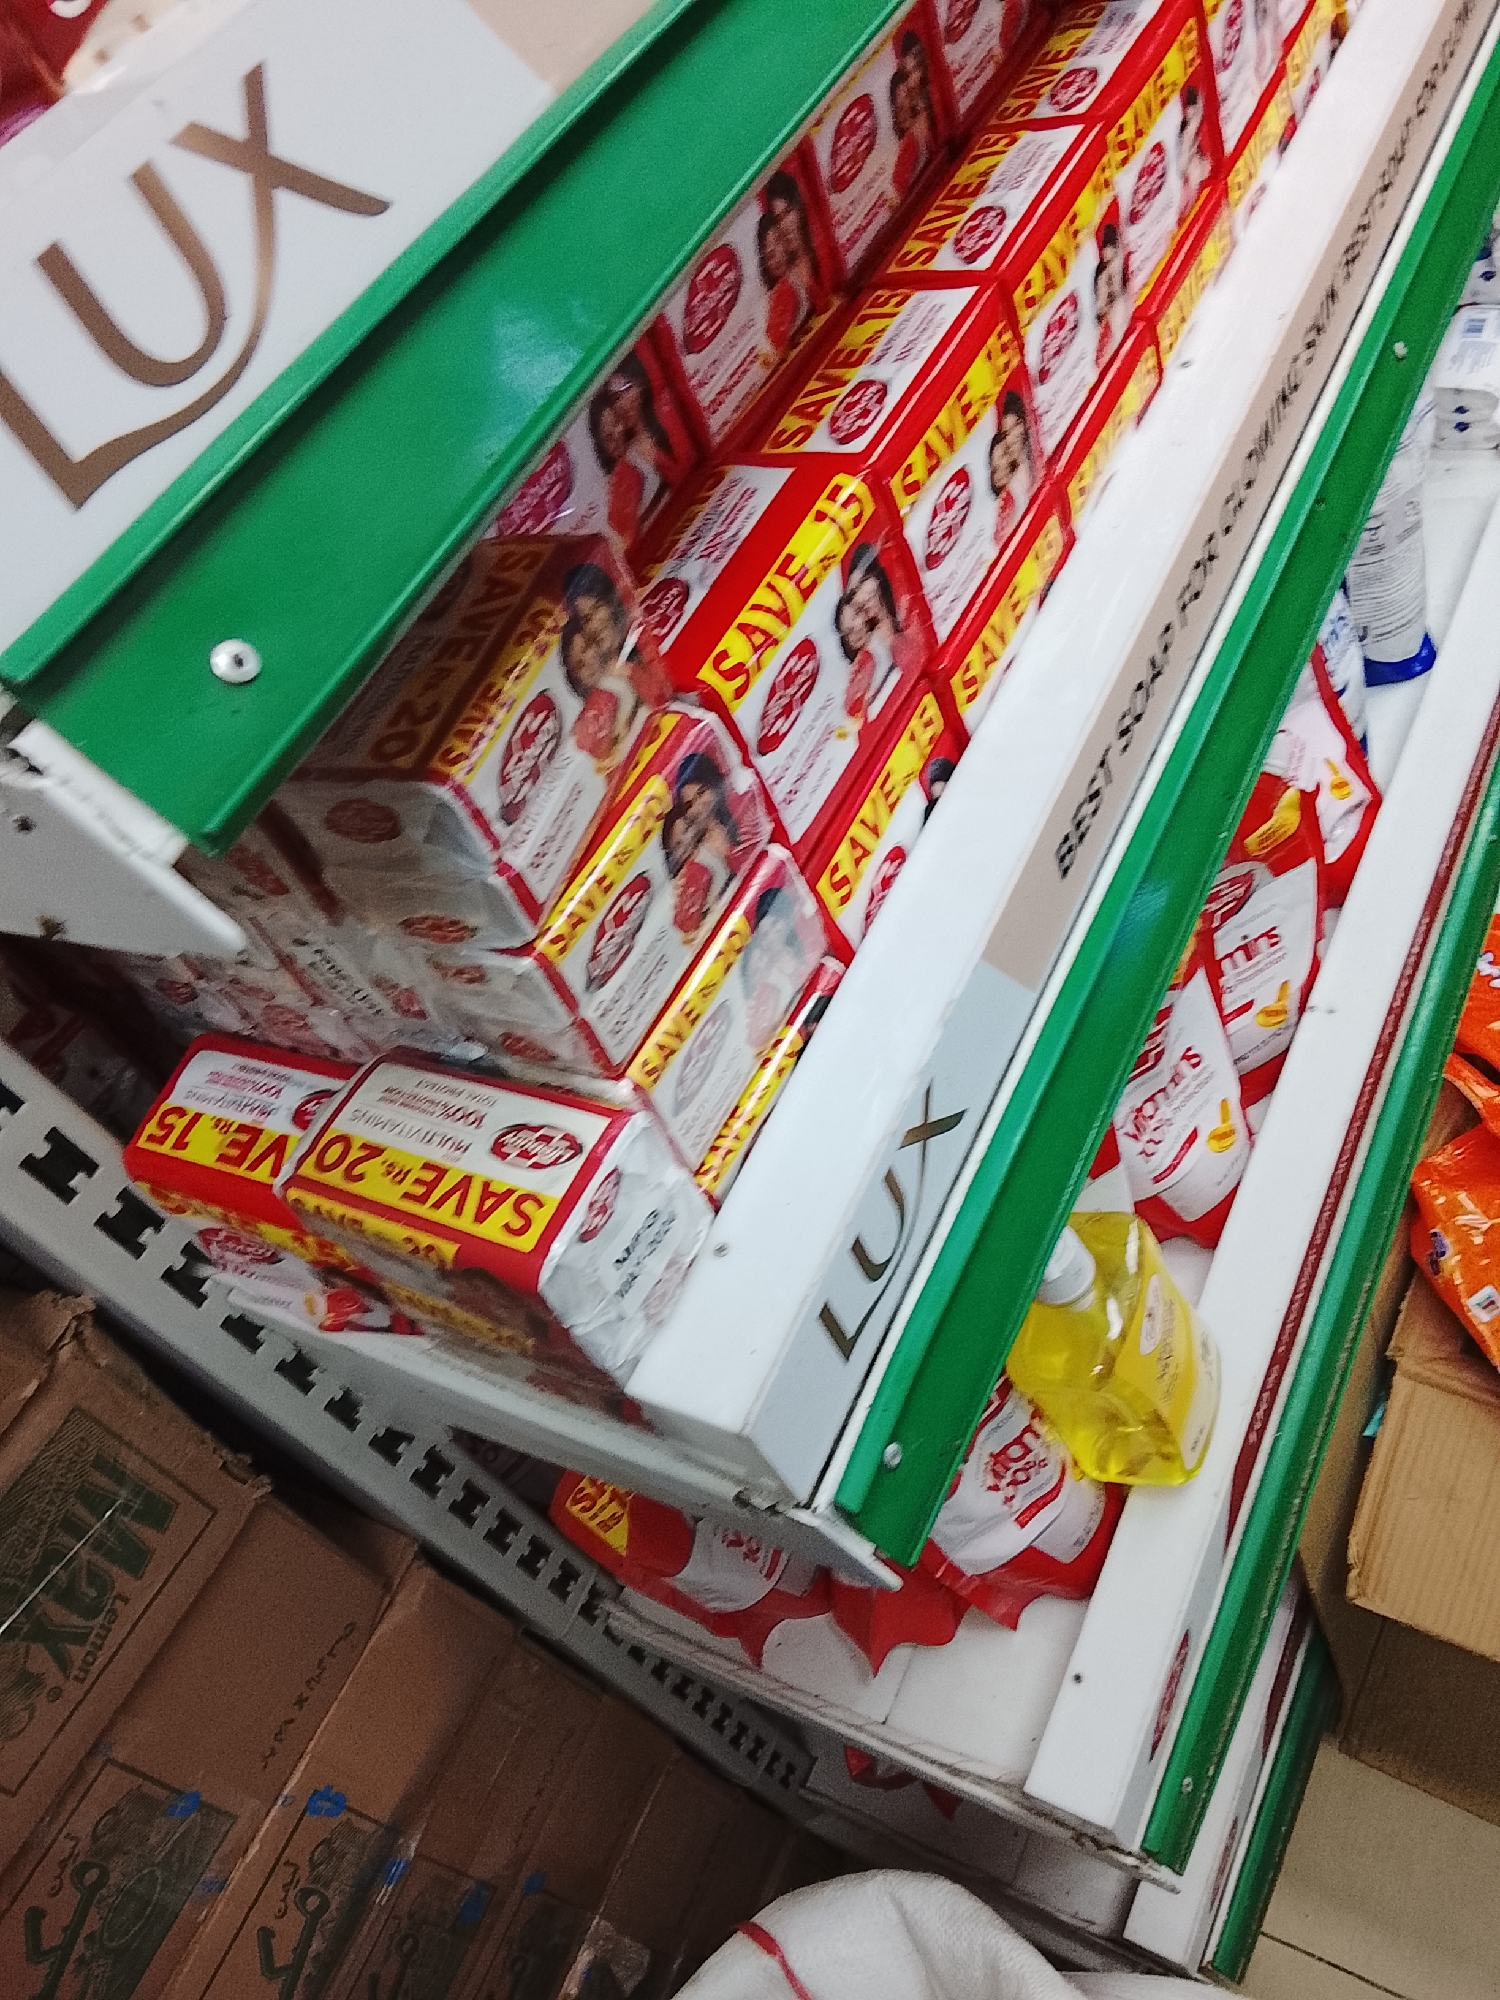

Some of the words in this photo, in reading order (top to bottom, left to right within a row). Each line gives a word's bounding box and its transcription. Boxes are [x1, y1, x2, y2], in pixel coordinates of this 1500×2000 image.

[895, 179, 988, 268] SAVE
[0, 60, 391, 512] LUX
[766, 347, 874, 450] SAVE
[713, 552, 818, 700] SAVE
[1055, 741, 1112, 880] BEST
[1117, 620, 1177, 756] SOAP
[829, 771, 900, 908] SAVE
[145, 1103, 202, 1151] 15
[312, 1130, 385, 1184] 20
[398, 1159, 545, 1237] SAVE
[817, 1077, 969, 1365] LUX
[71, 1591, 130, 1685] Lemon
